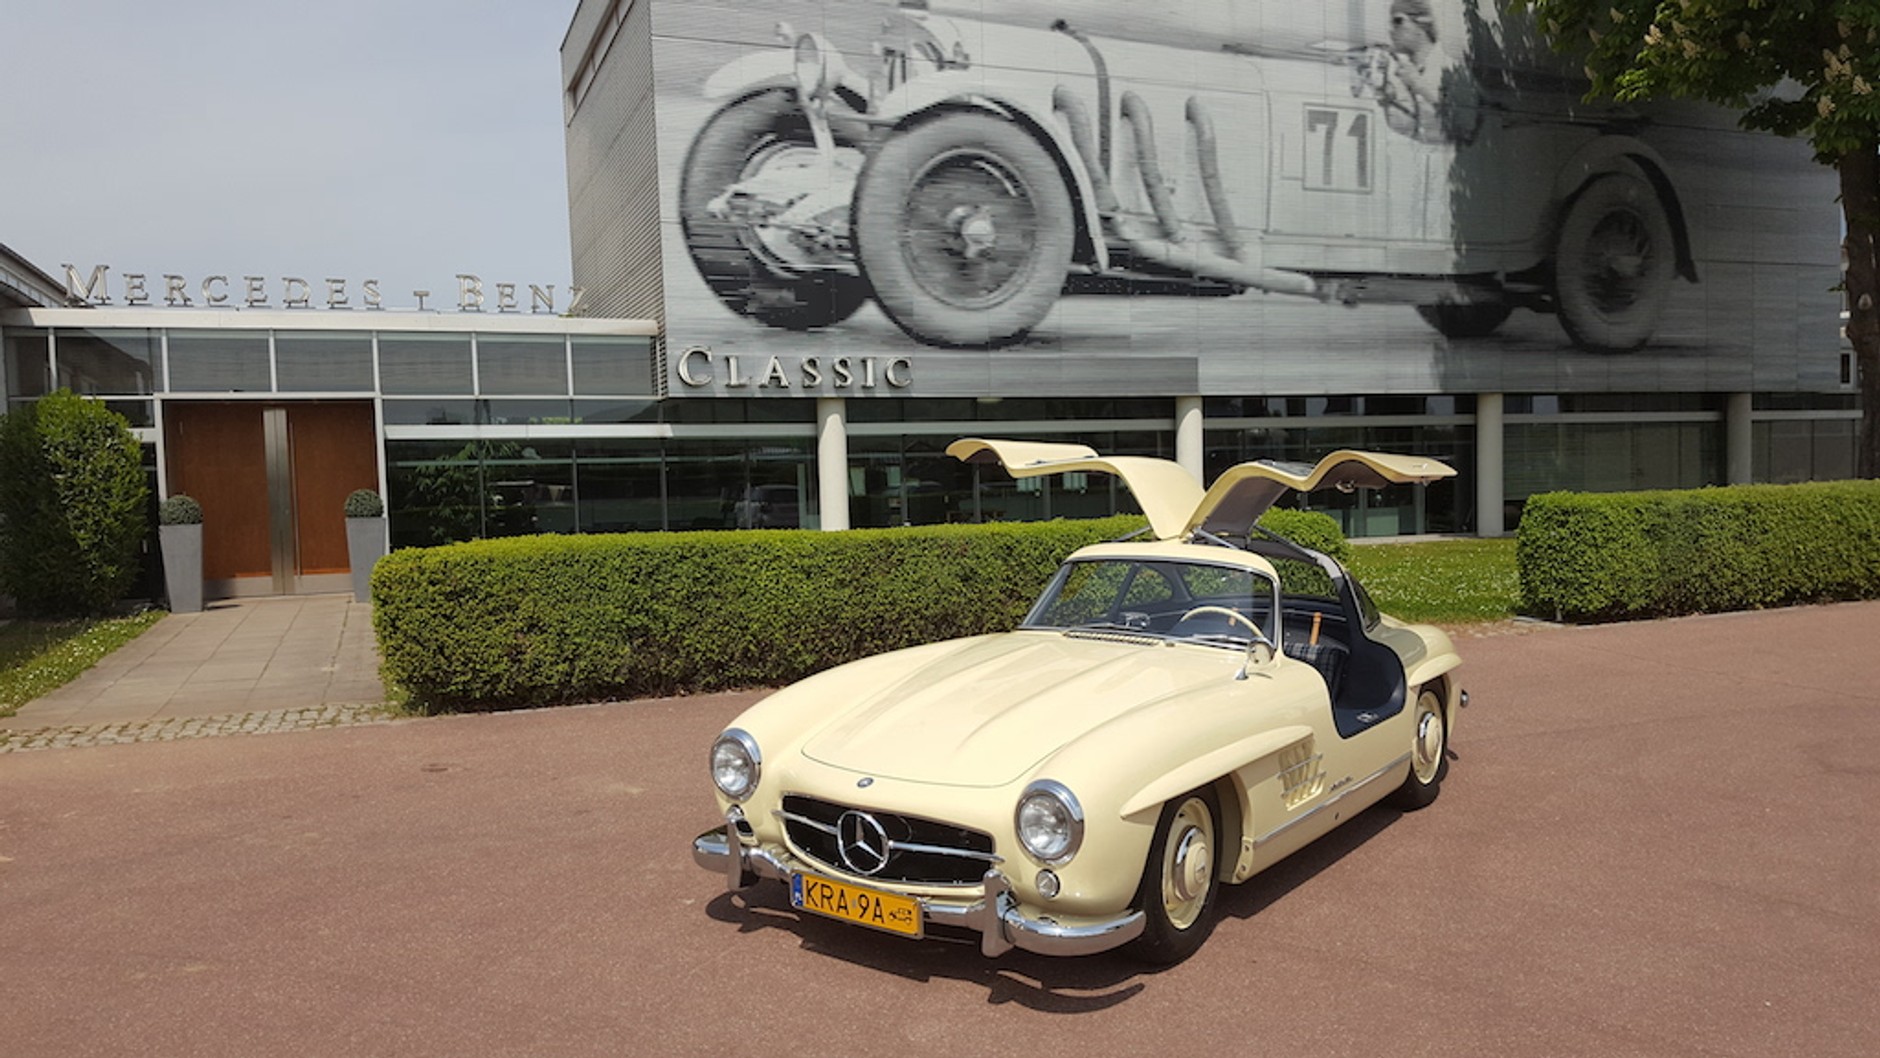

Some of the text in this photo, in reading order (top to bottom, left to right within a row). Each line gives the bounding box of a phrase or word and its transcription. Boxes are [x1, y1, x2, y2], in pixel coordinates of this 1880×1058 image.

[1307, 109, 1368, 188] 71
[677, 346, 912, 388] CLASSIC
[805, 879, 849, 916] KRA
[857, 893, 885, 924] 9A
